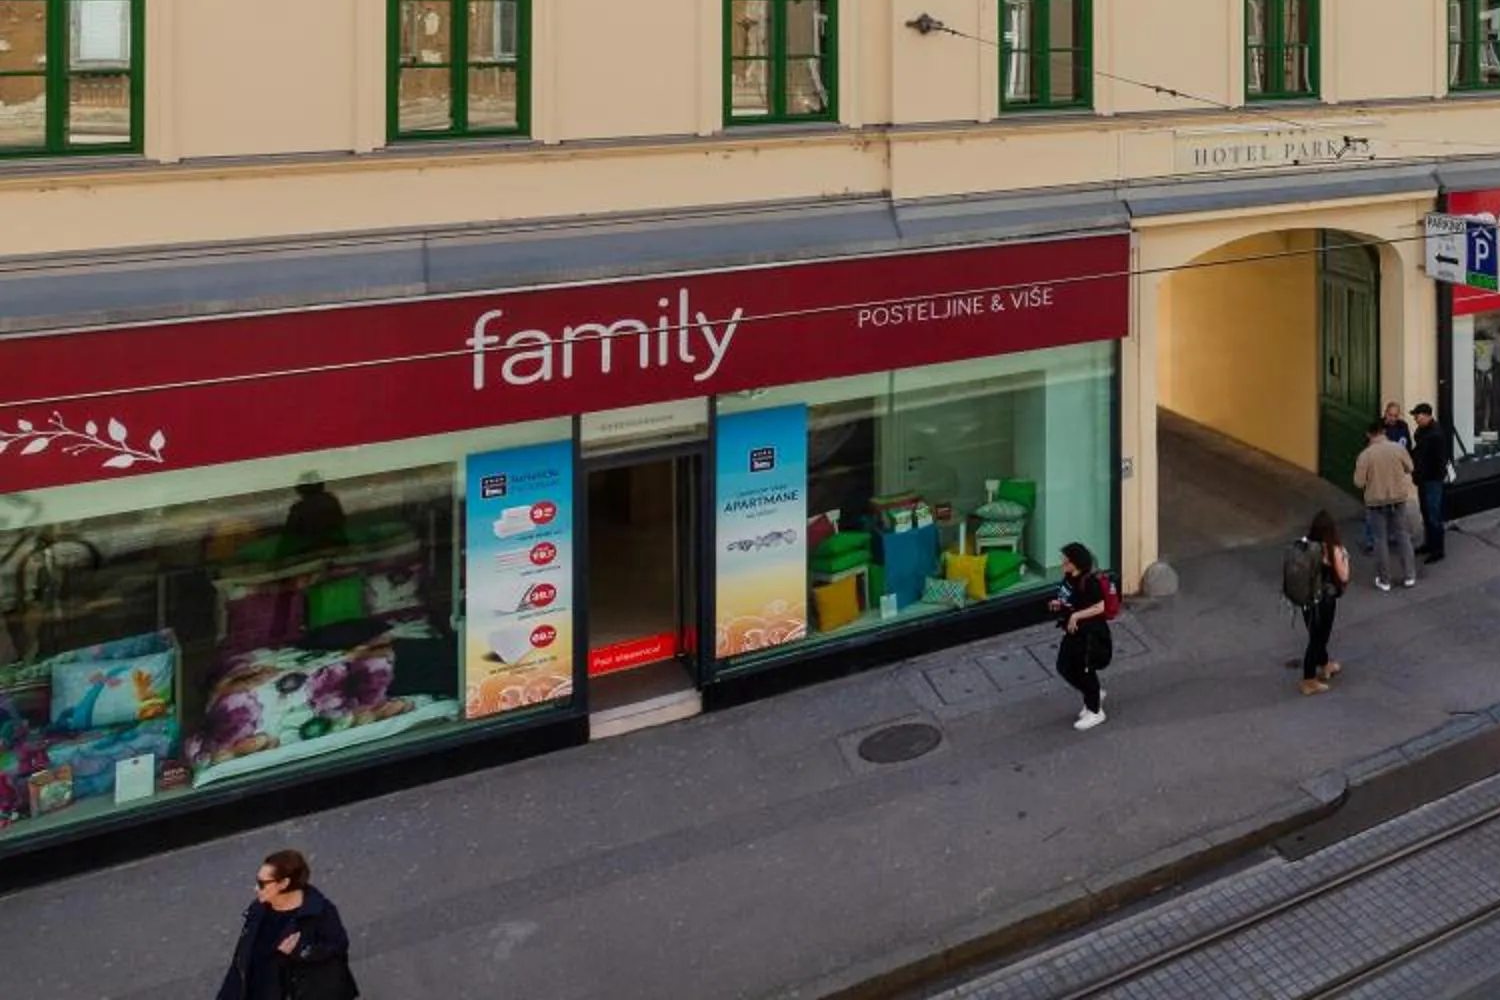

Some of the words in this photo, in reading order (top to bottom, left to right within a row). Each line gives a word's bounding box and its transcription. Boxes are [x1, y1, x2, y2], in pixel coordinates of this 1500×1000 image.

[1194, 144, 1269, 166] HOTEL
[1284, 139, 1339, 159] PARK
[857, 295, 985, 329] POSTELJINE
[990, 294, 1005, 313] &
[1010, 286, 1054, 309] VIŠE
[465, 287, 744, 391] family
[723, 489, 799, 513] APARTMANE
